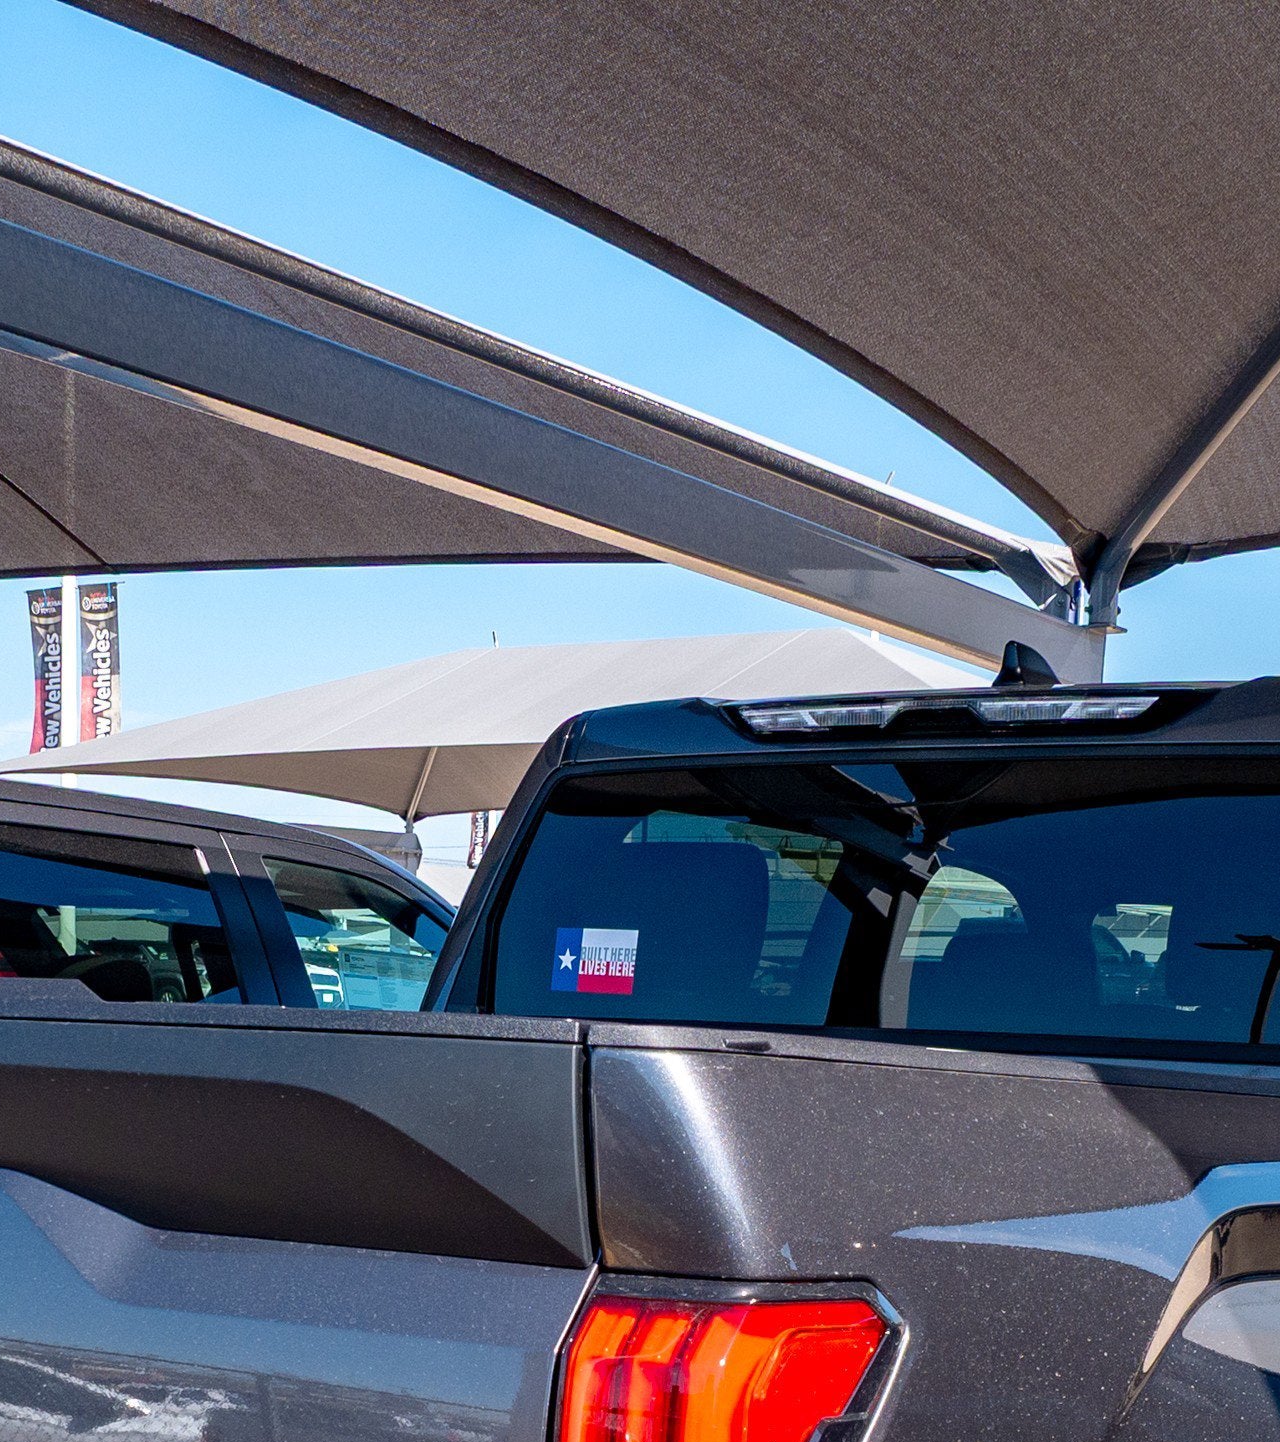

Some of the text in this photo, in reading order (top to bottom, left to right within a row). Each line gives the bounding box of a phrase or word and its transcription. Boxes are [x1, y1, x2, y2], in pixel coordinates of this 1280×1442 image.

[44, 632, 60, 715] Vehicles
[92, 628, 111, 714] Vehicles
[578, 960, 635, 977] LIVES HERE
[580, 946, 637, 963] BUILT HERE
